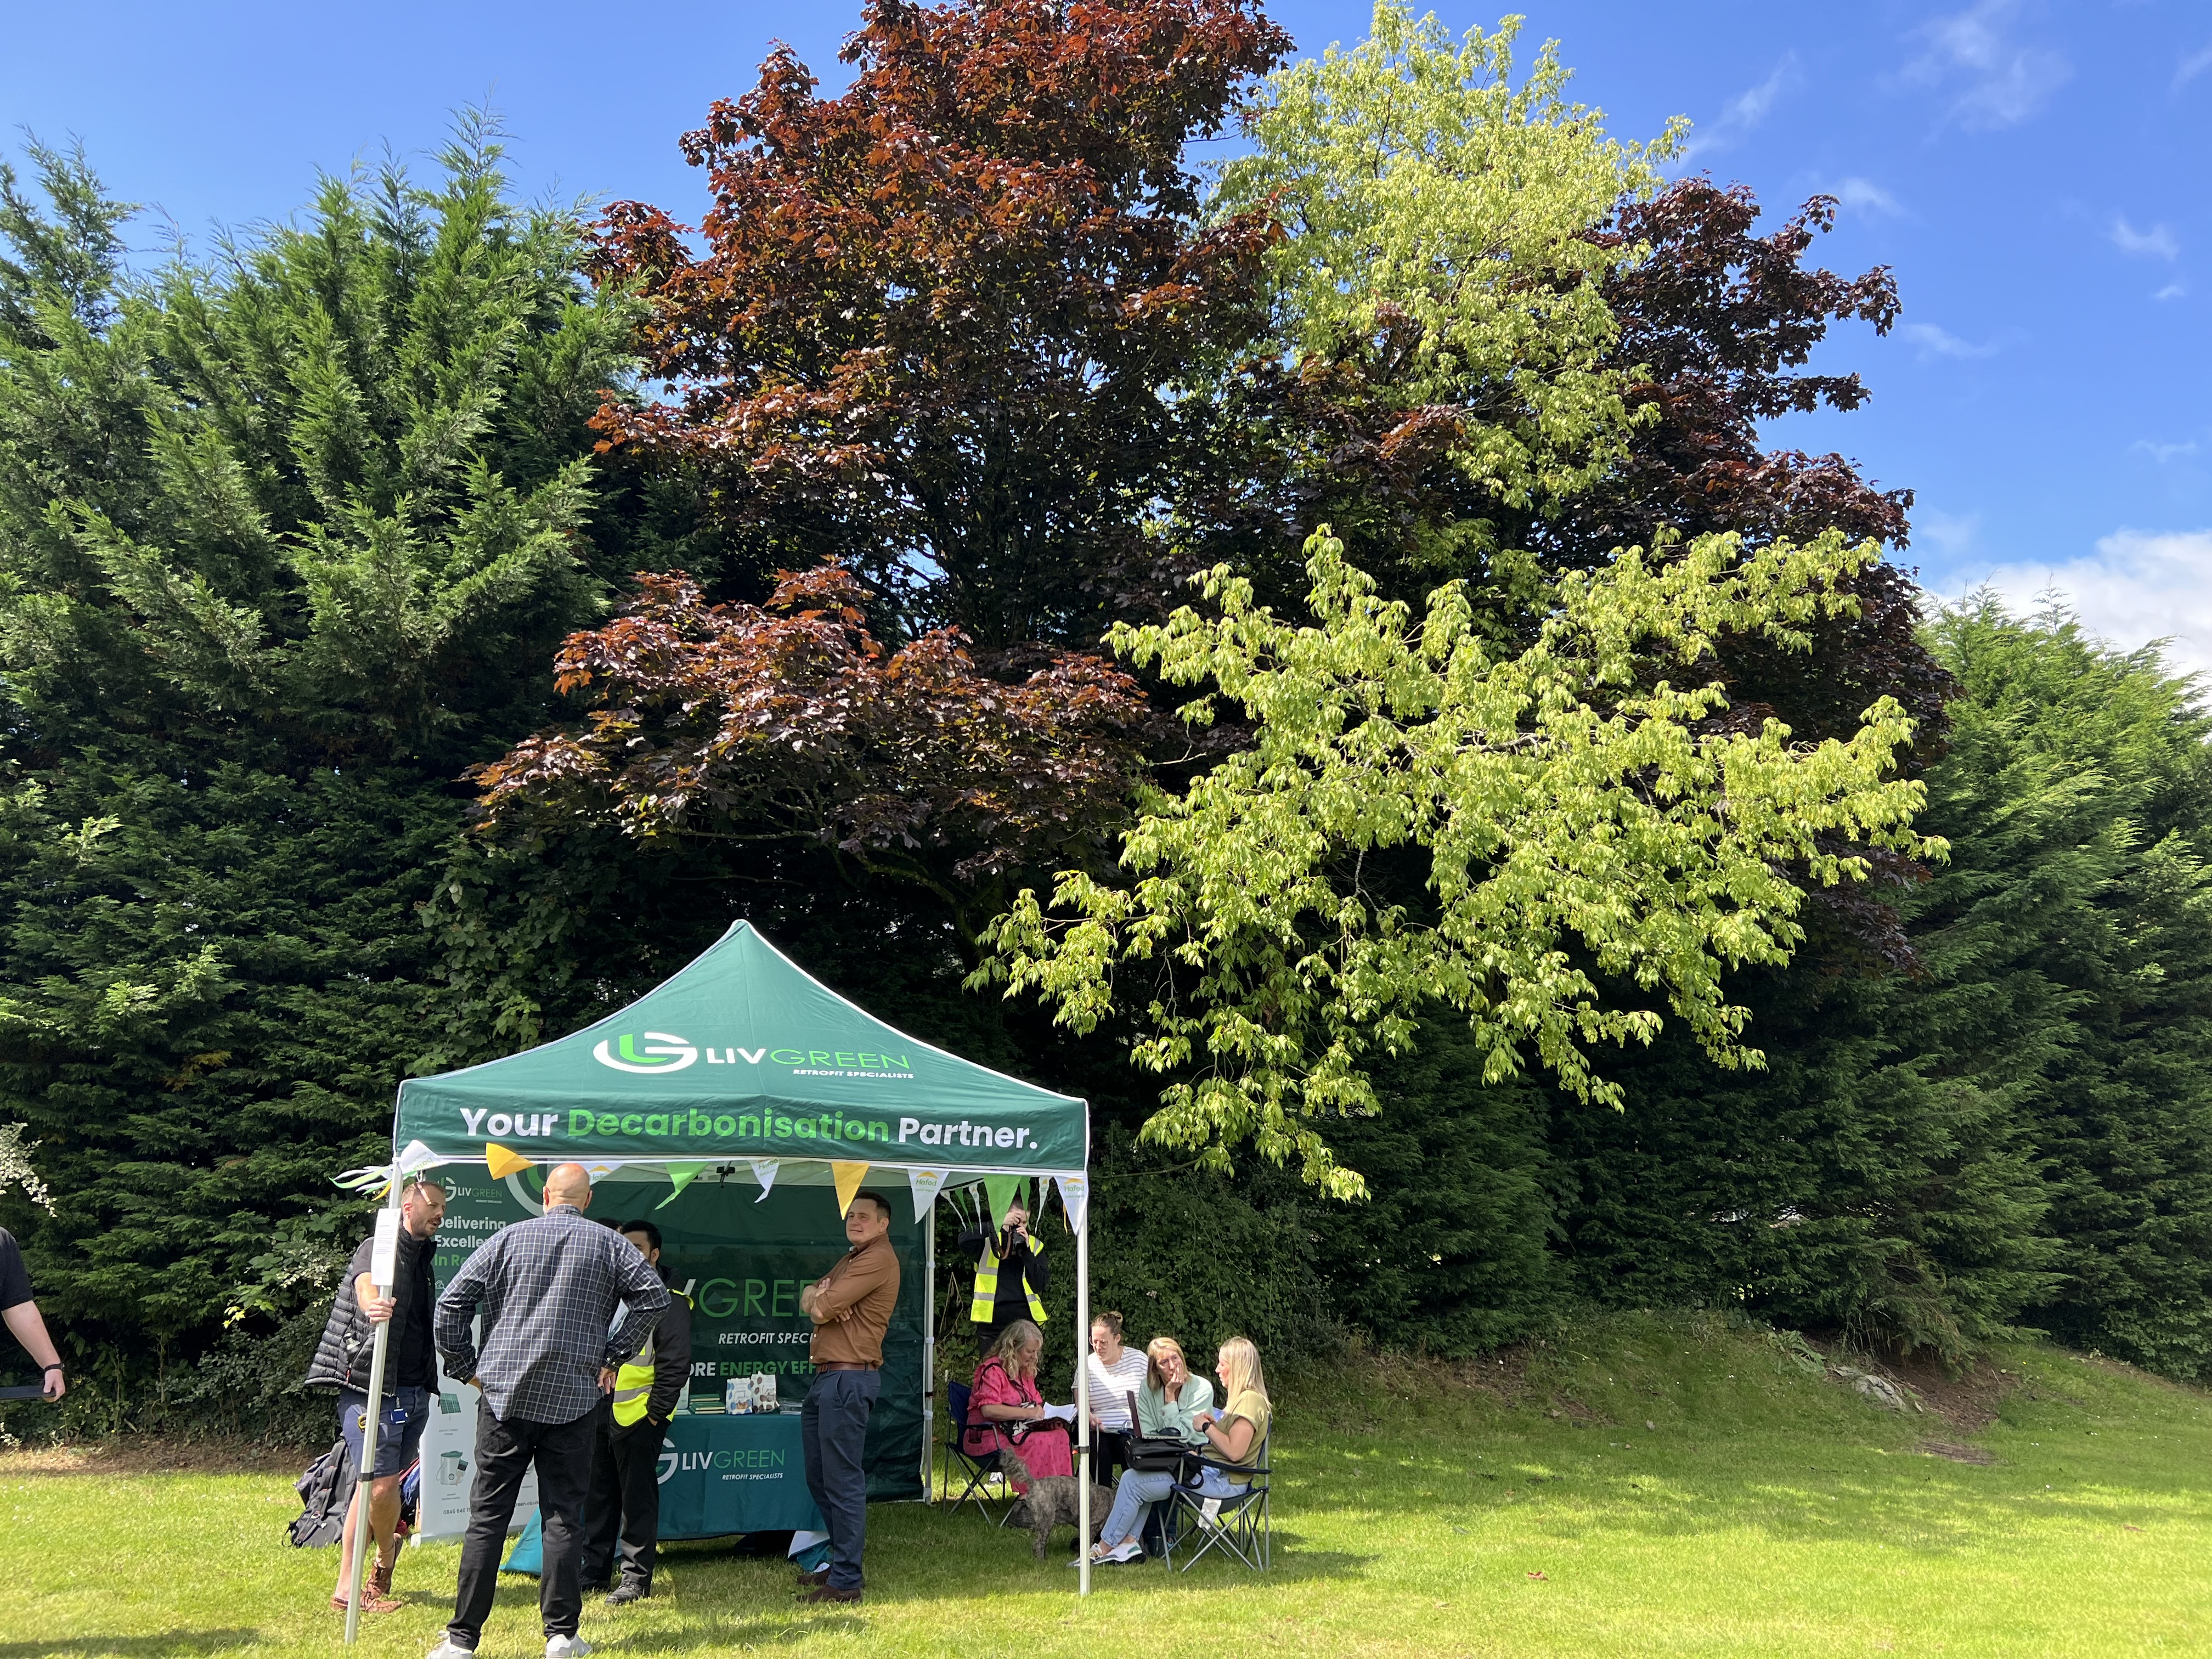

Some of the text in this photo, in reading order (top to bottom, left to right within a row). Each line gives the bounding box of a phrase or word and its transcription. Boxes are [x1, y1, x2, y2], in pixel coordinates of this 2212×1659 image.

[706, 1048, 910, 1069] LIVGREEN
[459, 1107, 1039, 1149] Your Decarbonisation Partner.
[458, 1187, 503, 1198] LIVGREEN
[435, 1234, 488, 1248] Excelle
[434, 1254, 448, 1266] In
[718, 1333, 775, 1345] RETROFIT
[720, 1361, 788, 1376] ENERGY
[682, 1449, 785, 1470] LIVGREEN
